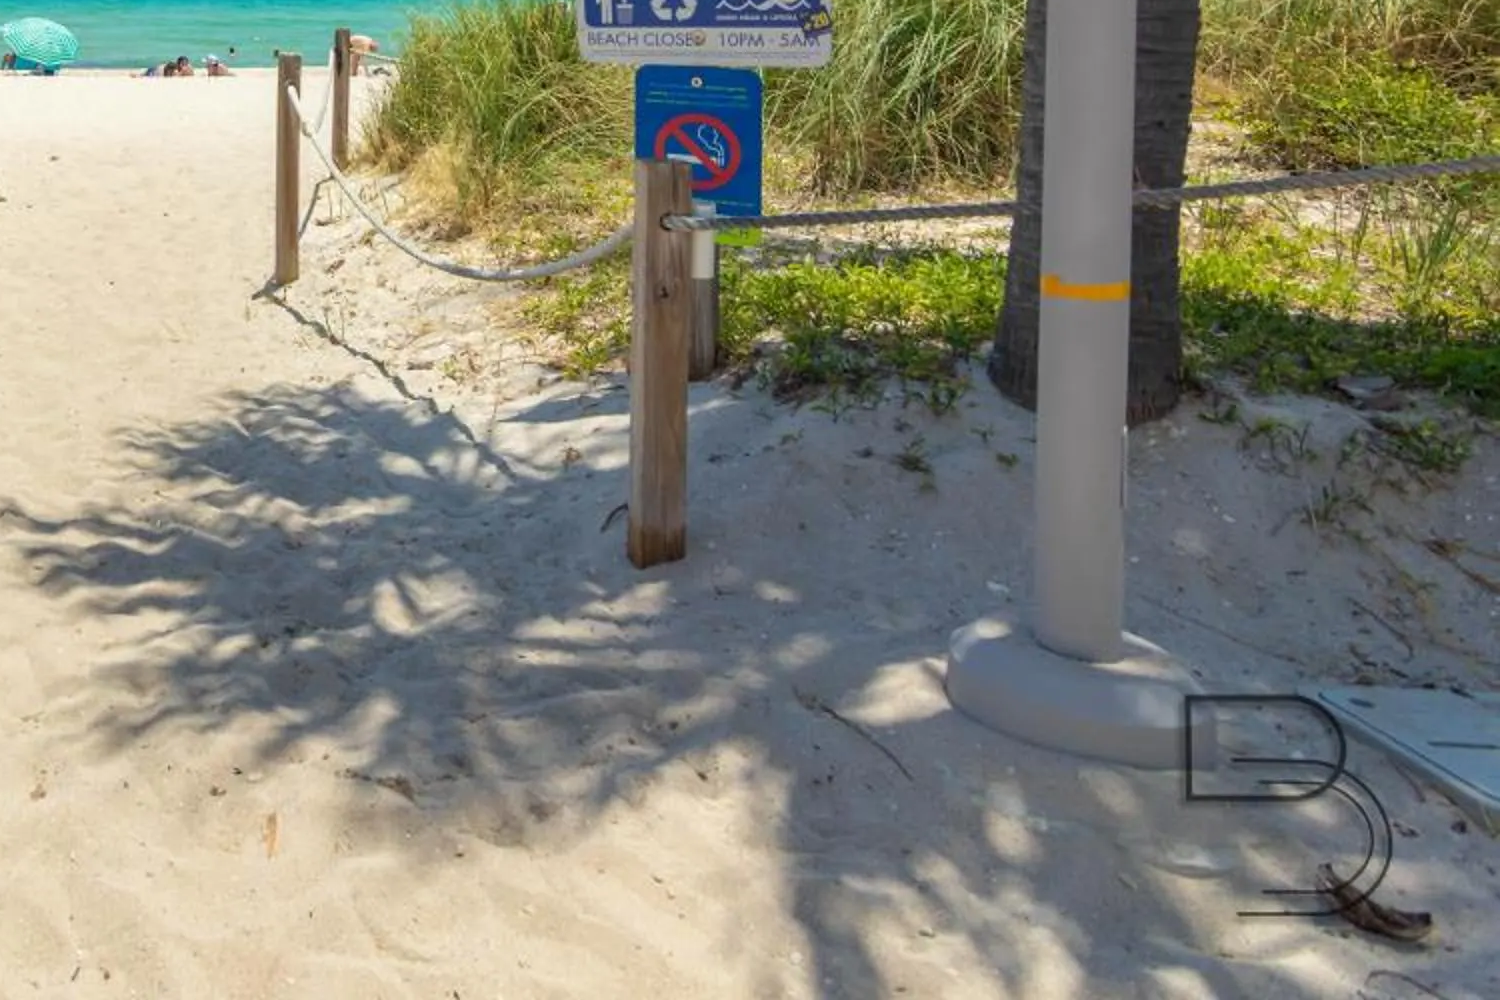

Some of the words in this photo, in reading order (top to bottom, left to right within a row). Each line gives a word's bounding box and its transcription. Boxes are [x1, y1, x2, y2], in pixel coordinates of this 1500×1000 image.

[587, 31, 638, 46] BEACH
[643, 30, 705, 46] CLOSE
[718, 32, 766, 47] 10PM
